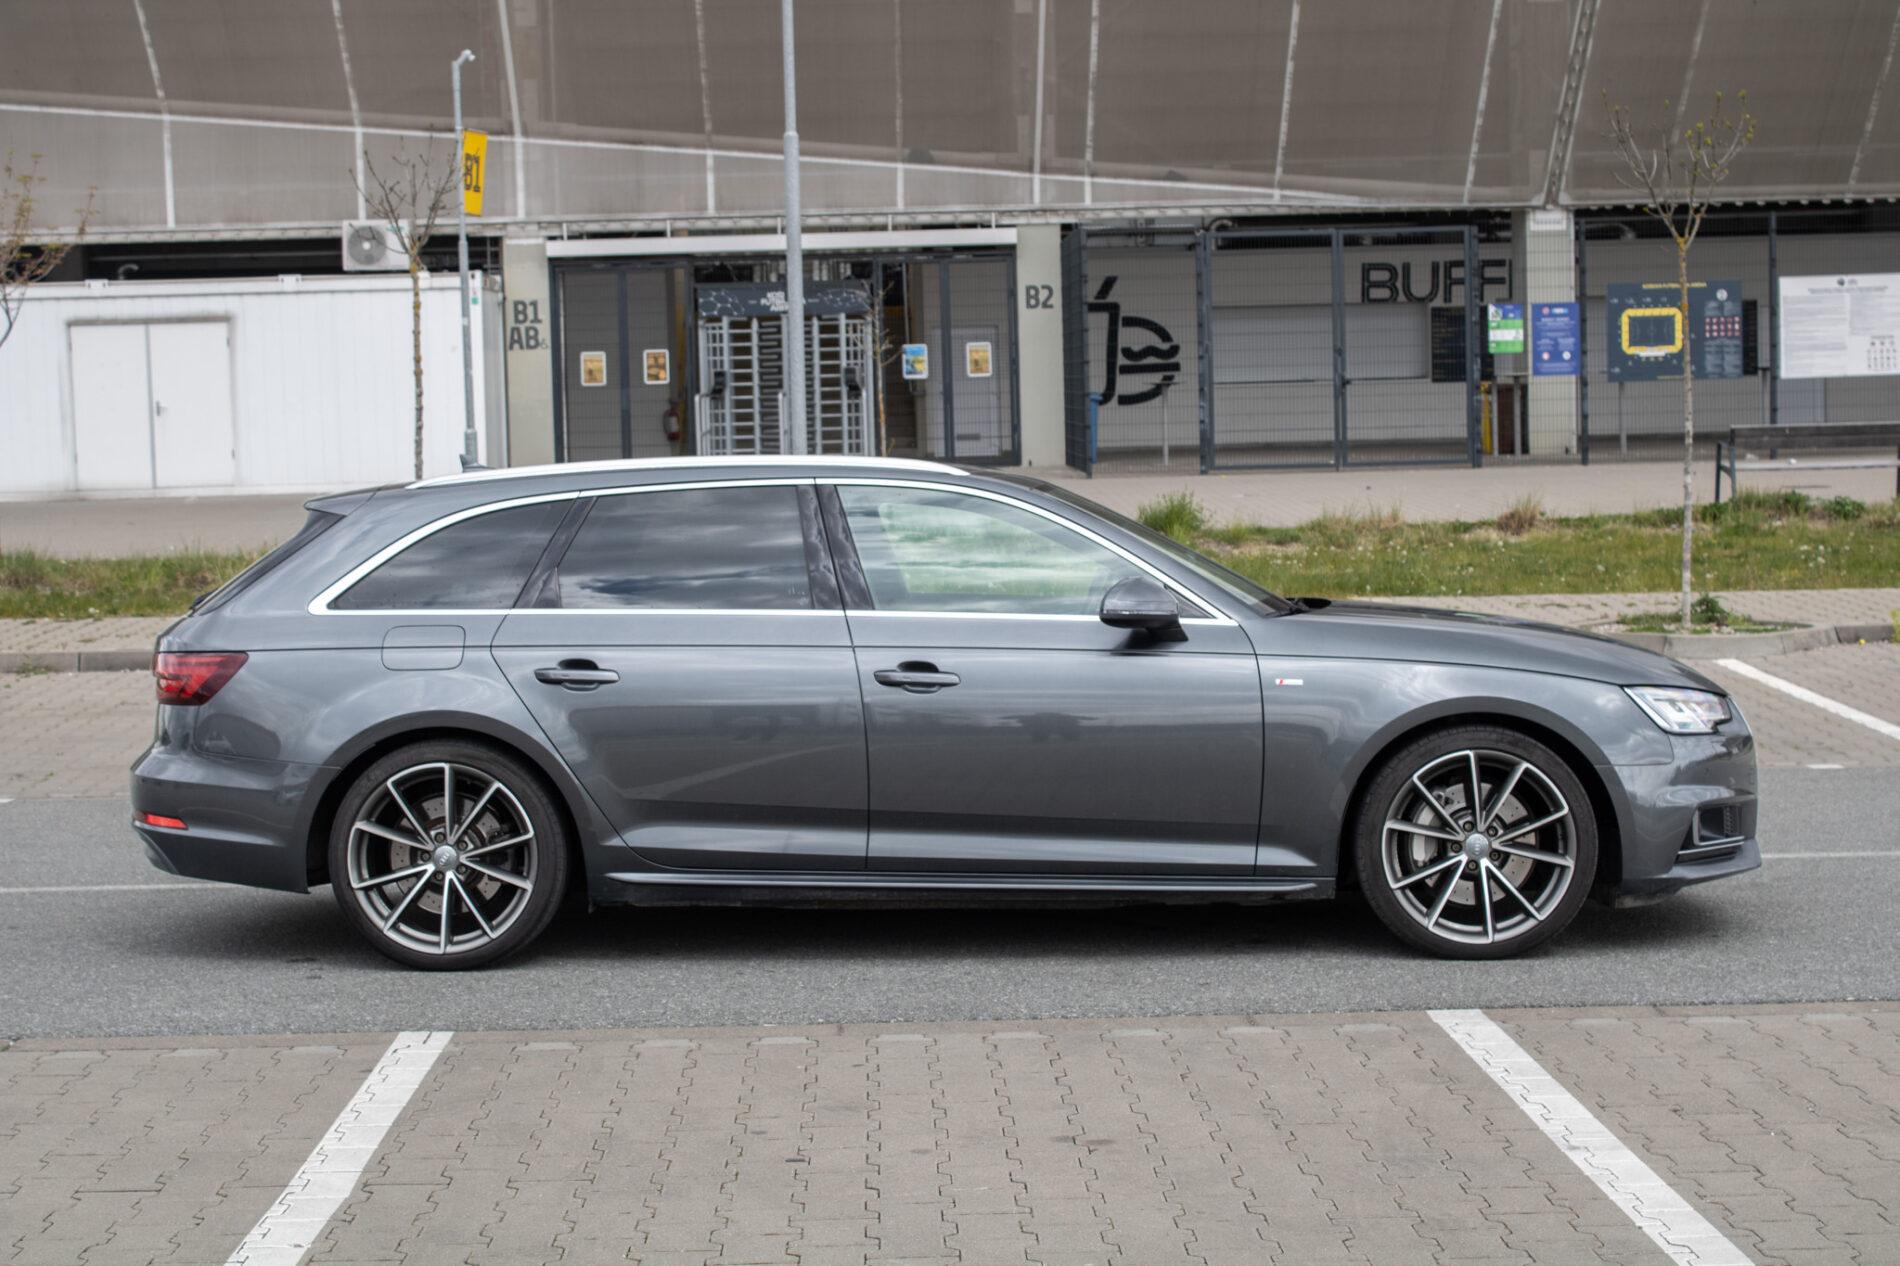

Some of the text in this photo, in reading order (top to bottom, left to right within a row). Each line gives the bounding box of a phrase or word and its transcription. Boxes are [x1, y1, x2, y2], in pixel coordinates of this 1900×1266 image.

[1361, 259, 1512, 303] BUFF
[1025, 284, 1054, 309] B2
[513, 300, 543, 324] B1
